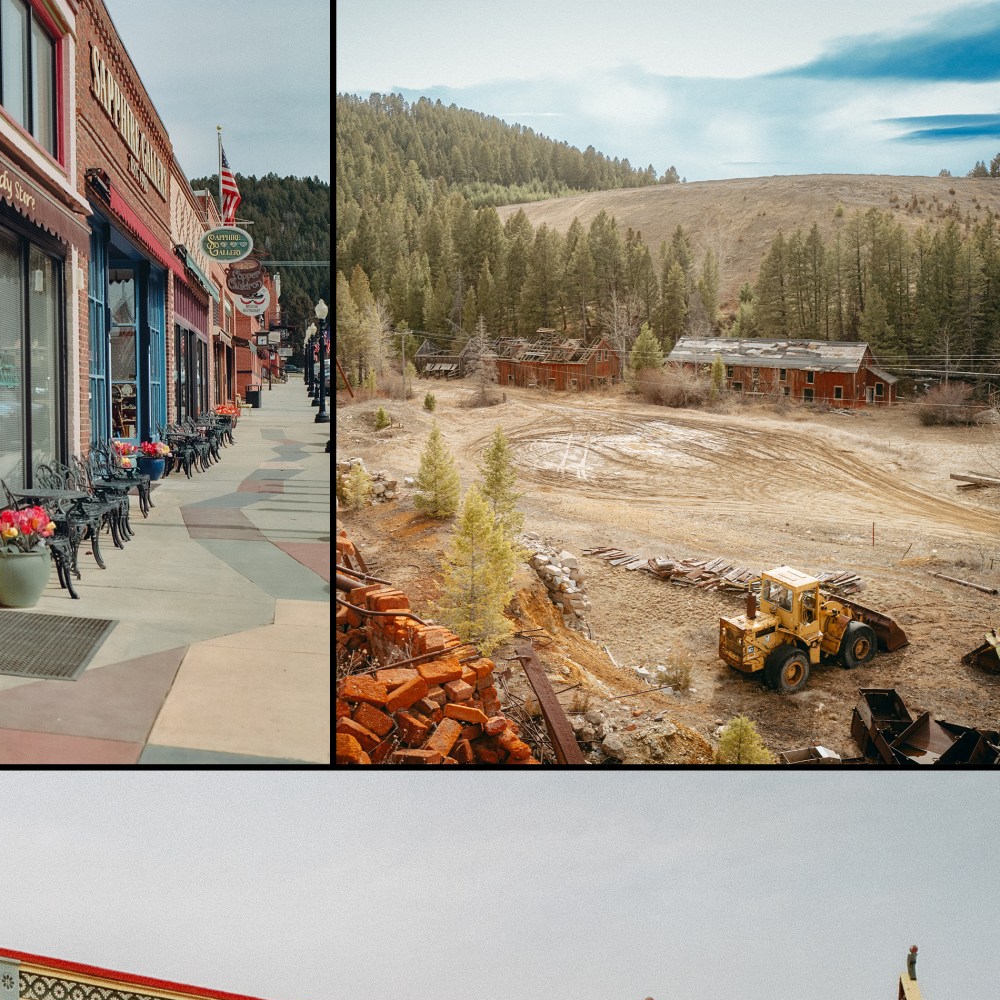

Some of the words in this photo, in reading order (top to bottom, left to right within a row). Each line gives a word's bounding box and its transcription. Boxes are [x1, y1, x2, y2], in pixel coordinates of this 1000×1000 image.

[91, 44, 140, 162] SAPPHIRE
[14, 180, 36, 211] Store
[209, 247, 242, 257] GALLERY
